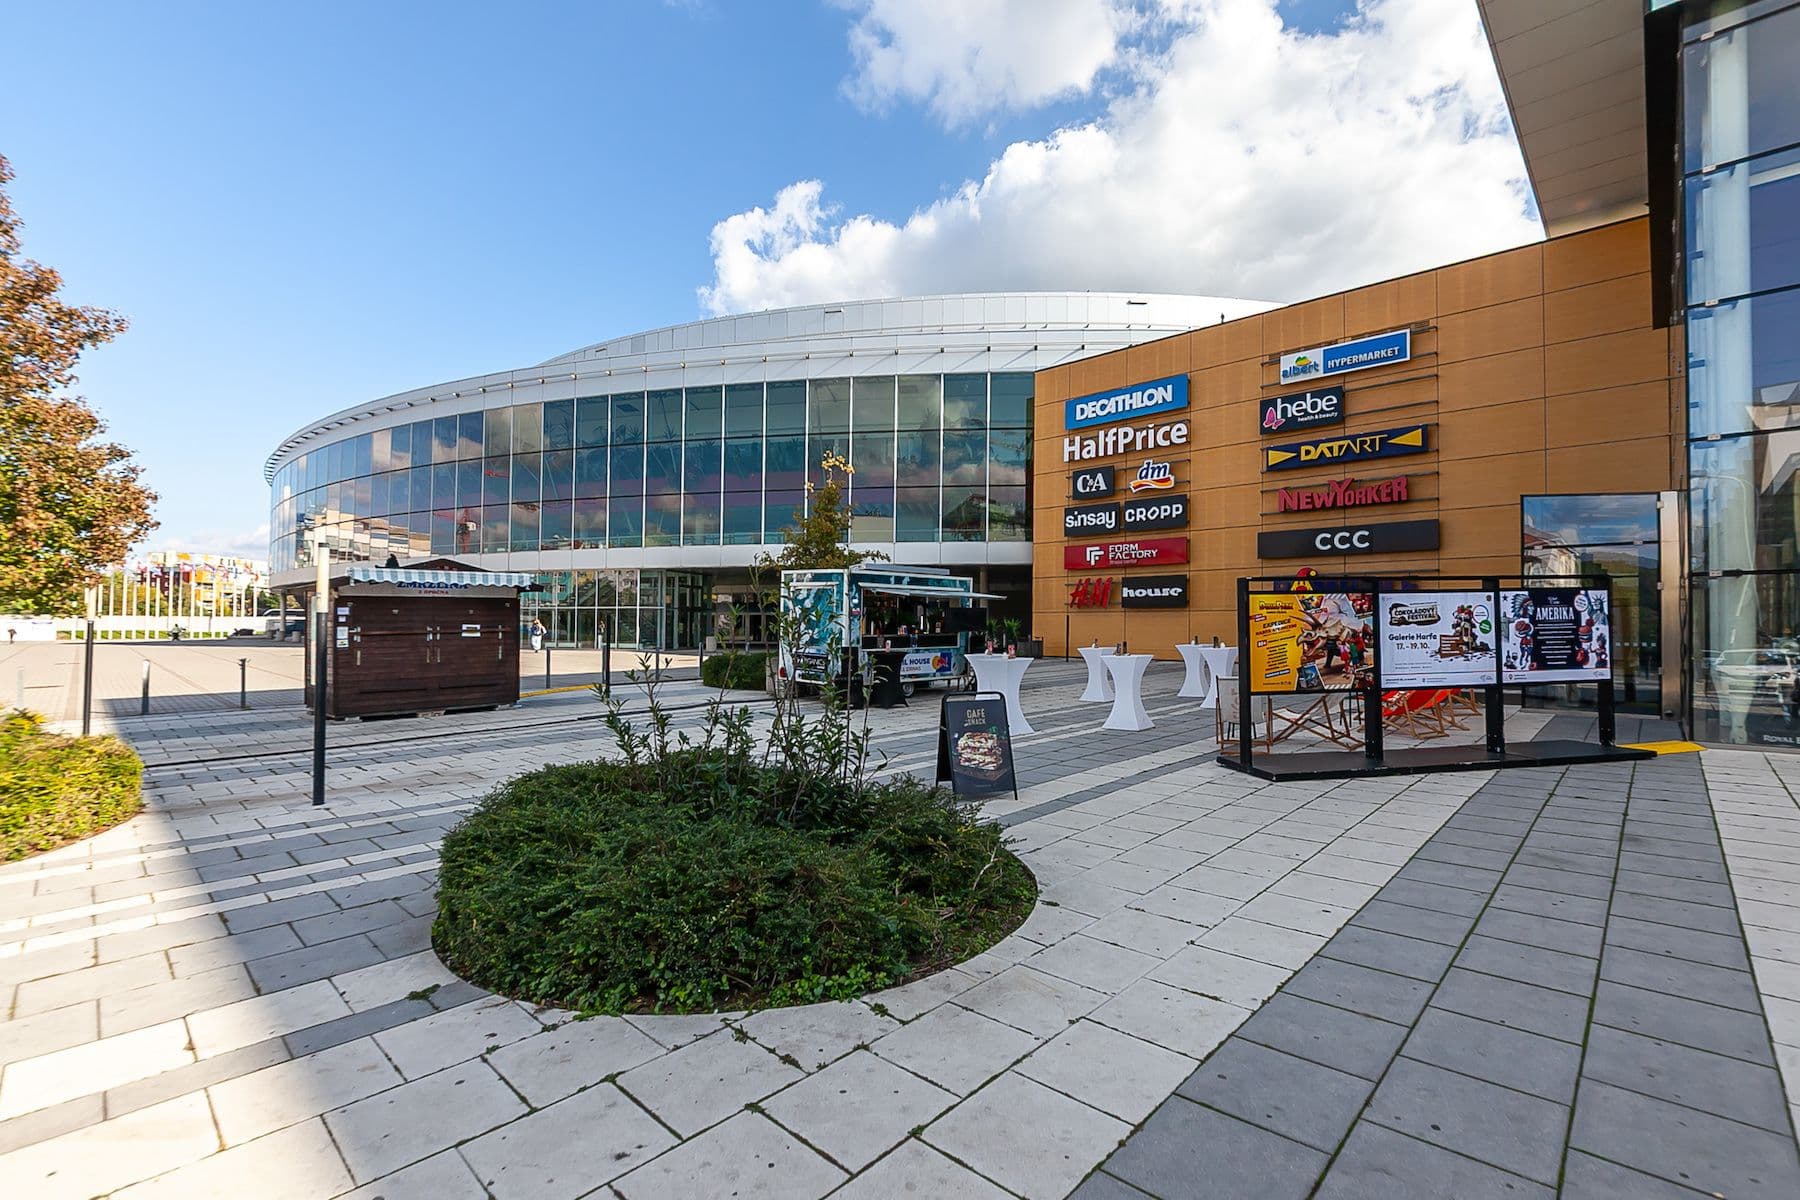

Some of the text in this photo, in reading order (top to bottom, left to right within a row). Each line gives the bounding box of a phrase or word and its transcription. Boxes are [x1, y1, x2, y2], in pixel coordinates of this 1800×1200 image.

[1282, 346, 1400, 378] albert HYPERMARKET
[1075, 384, 1173, 420] DECATHLON
[1276, 393, 1338, 418] hebe
[1063, 422, 1188, 462] HalfPrice
[1300, 434, 1388, 462] DATART
[1138, 461, 1168, 480] dm
[1076, 473, 1107, 493] C&A
[1066, 510, 1116, 529] sinsay
[1125, 503, 1183, 522] CROPP
[1109, 544, 1138, 552] FORM
[1315, 530, 1370, 550] CCC
[1109, 549, 1158, 560] FACTORY
[1069, 576, 1113, 609] H&M
[1122, 586, 1184, 597] house
[1536, 607, 1574, 620] AMERIKA
[1764, 735, 1794, 743] ROYAL
